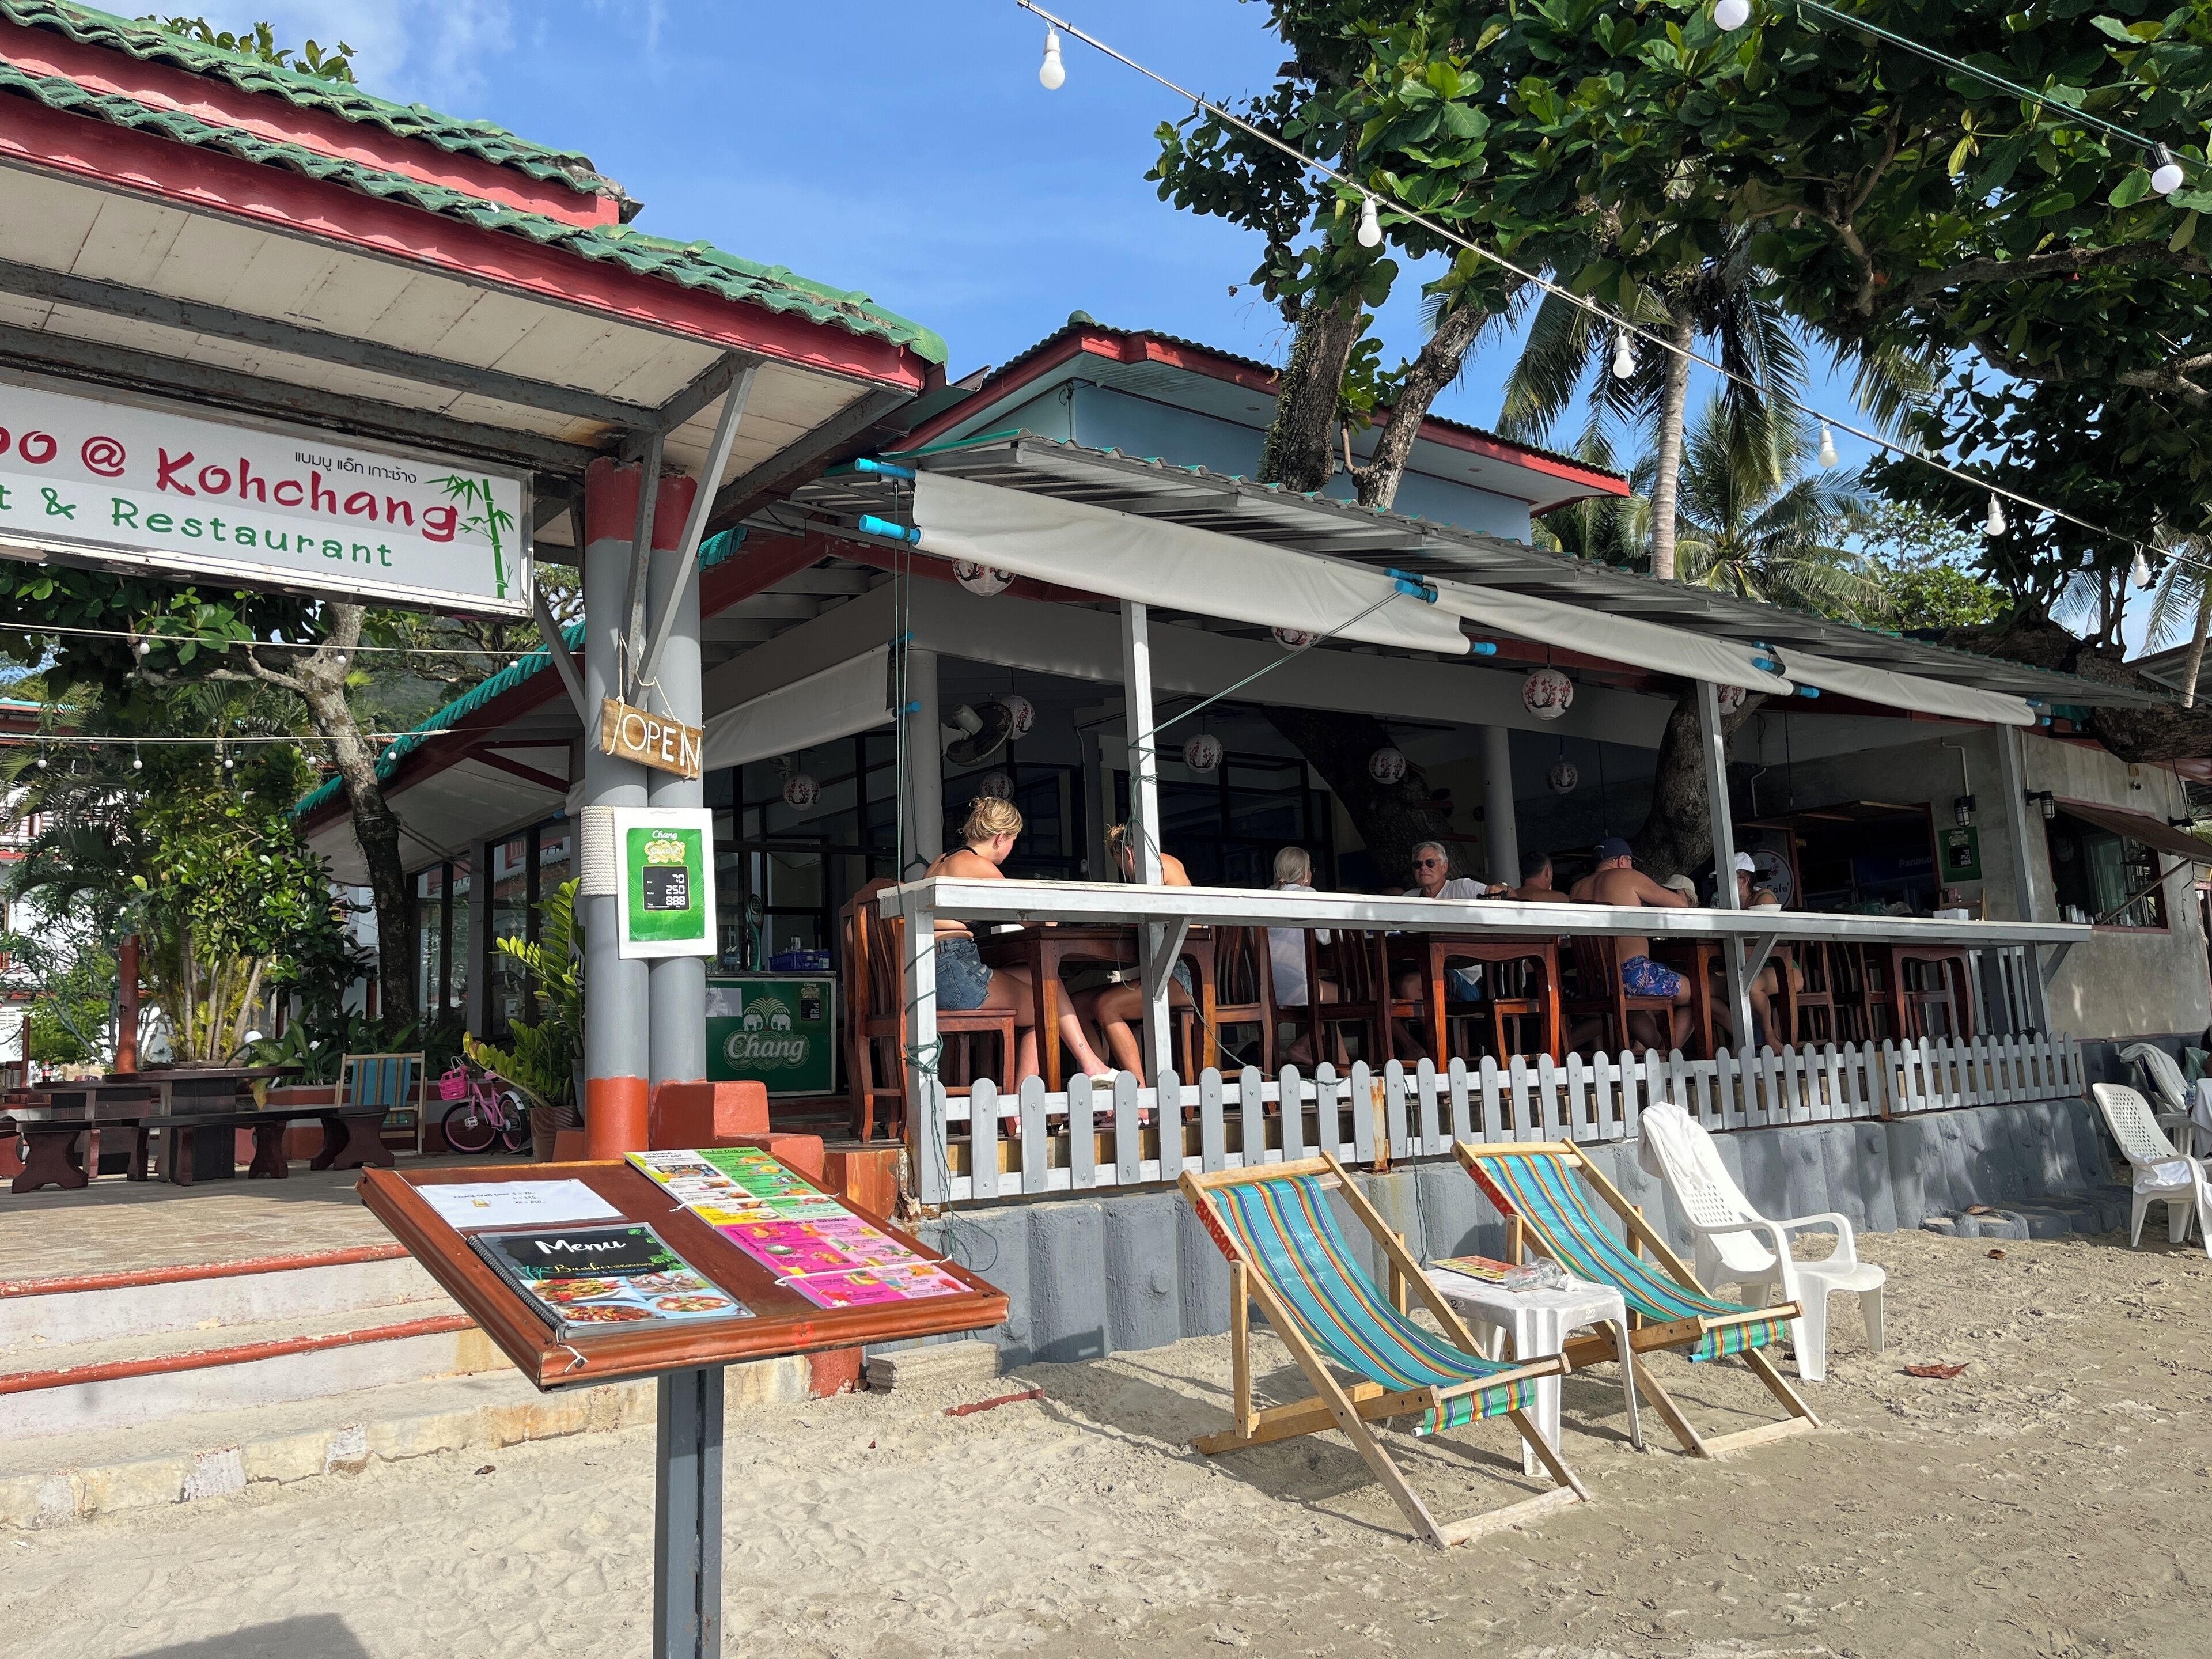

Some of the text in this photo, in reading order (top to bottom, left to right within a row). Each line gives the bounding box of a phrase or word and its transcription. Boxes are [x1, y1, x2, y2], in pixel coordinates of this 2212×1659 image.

[294, 452, 332, 472] แบมบู
[369, 466, 417, 483] เกาะช้าง
[81, 436, 125, 477] @
[156, 448, 459, 542] Kohchang
[41, 487, 77, 520] &
[111, 497, 392, 567] Restaurant
[622, 713, 701, 771] OPEN
[652, 830, 678, 840] Chang
[672, 874, 685, 884] 70
[666, 885, 685, 895] 250
[666, 896, 686, 906] 888
[728, 1034, 804, 1062] Chang
[535, 1239, 626, 1254] Menu
[1450, 1299, 1466, 1311] 22
[1585, 1308, 1596, 1320] 22
